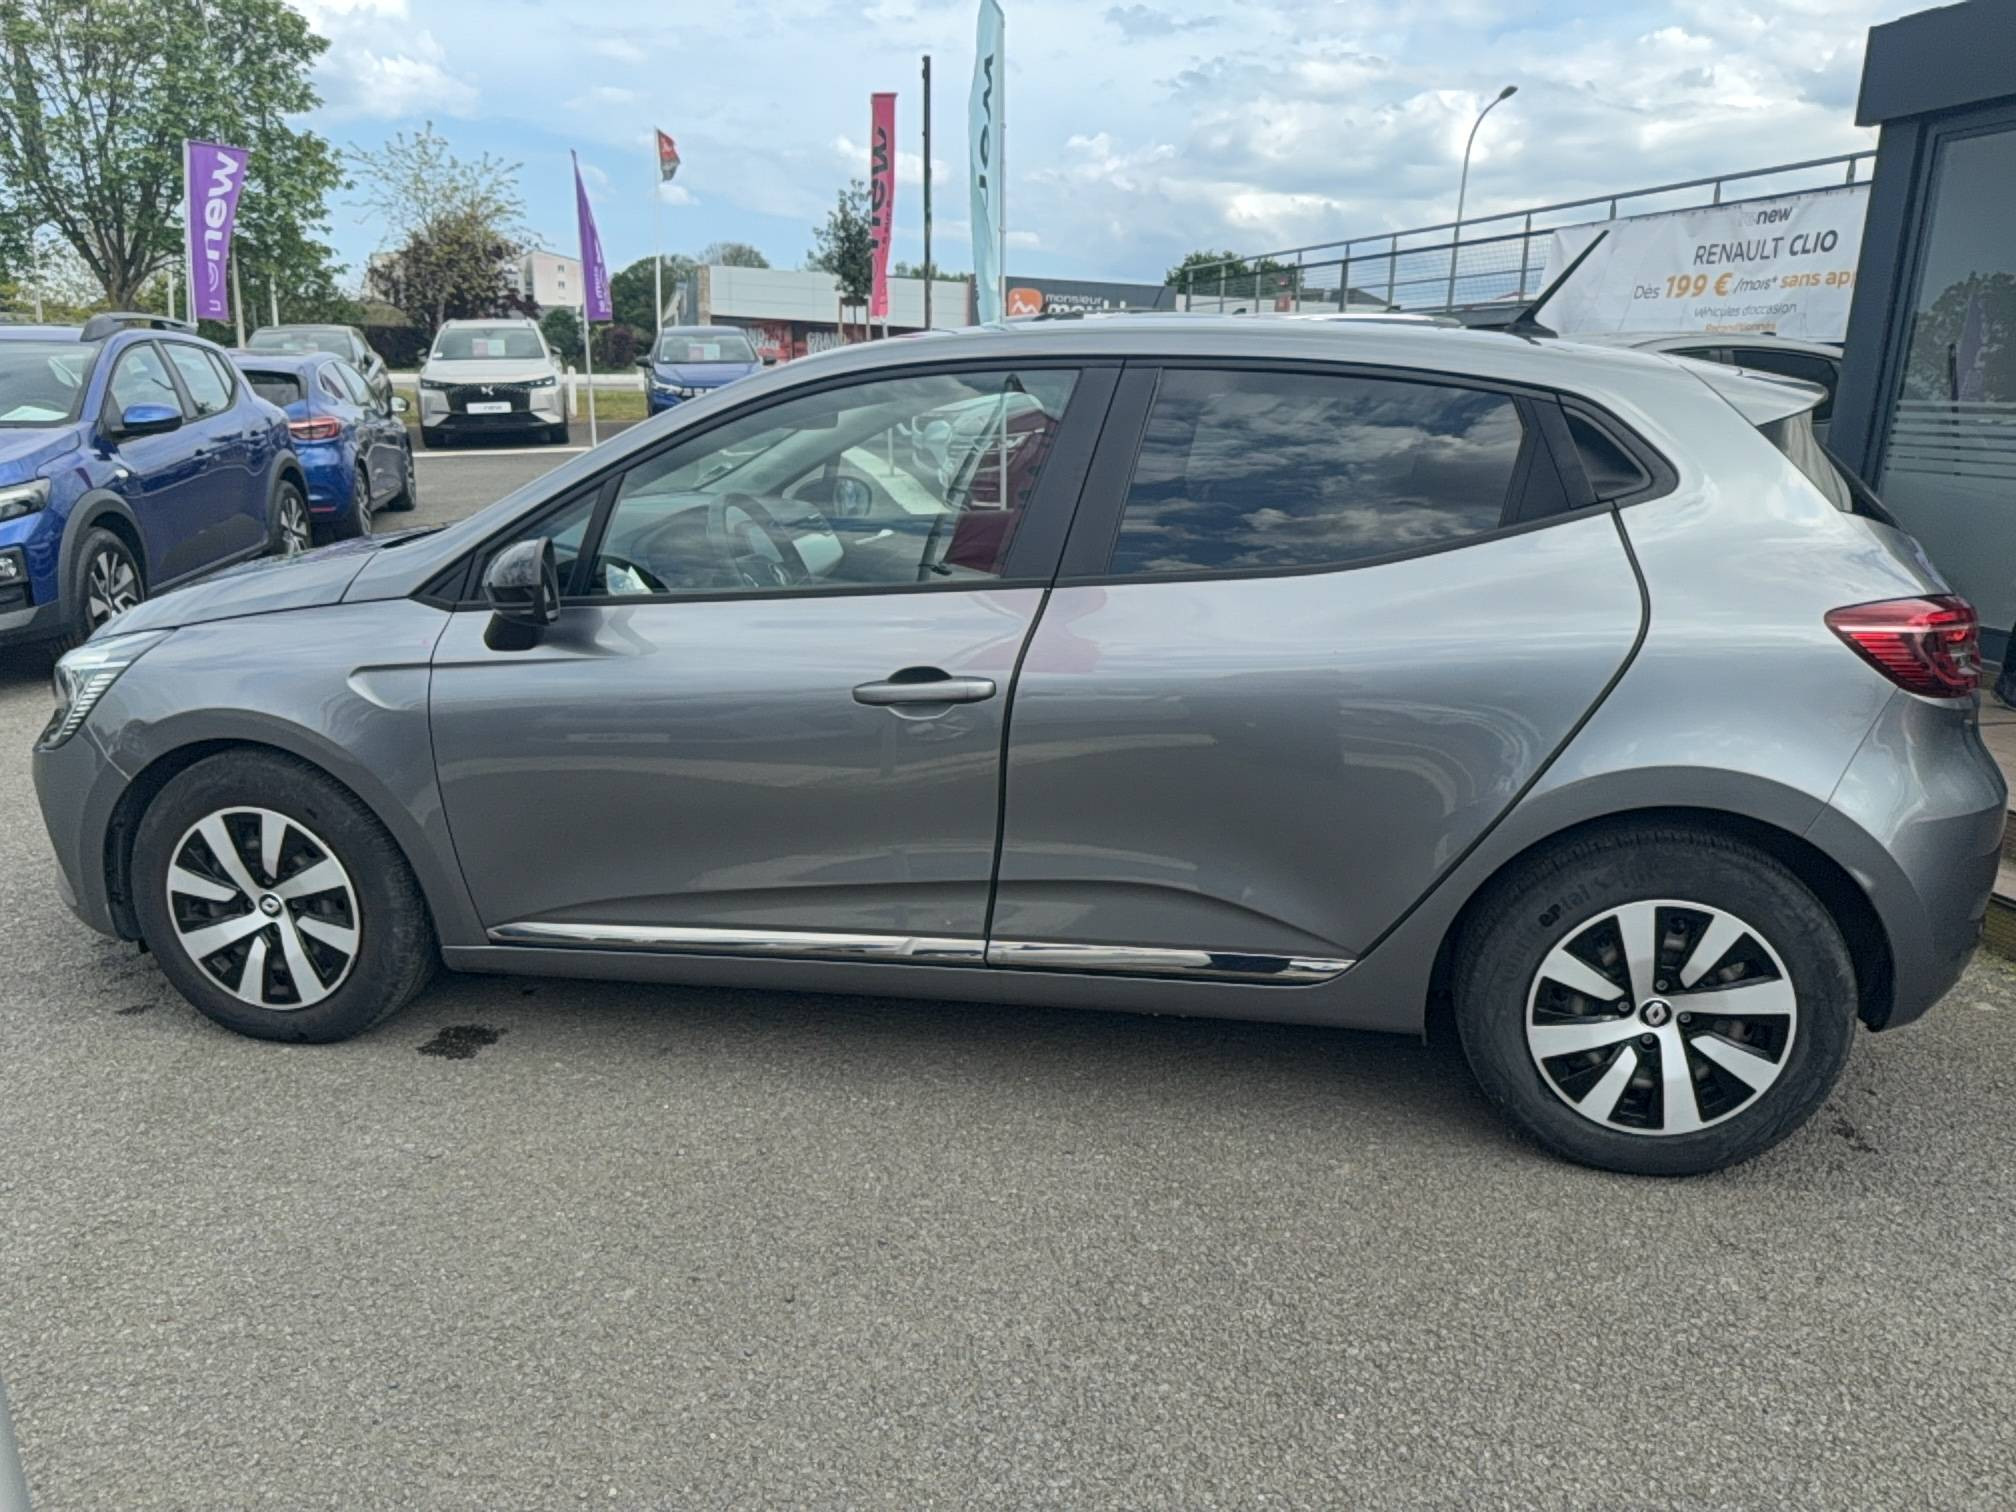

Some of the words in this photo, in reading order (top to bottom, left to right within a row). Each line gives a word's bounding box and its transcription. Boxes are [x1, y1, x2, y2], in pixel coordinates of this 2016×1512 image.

[1693, 237, 1784, 265] RENAULT
[1789, 230, 1839, 257] CLIO
[1665, 272, 1708, 299] 199
[1714, 271, 1733, 298] €
[1779, 271, 1822, 288] sans
[1045, 294, 1103, 305] monsieur
